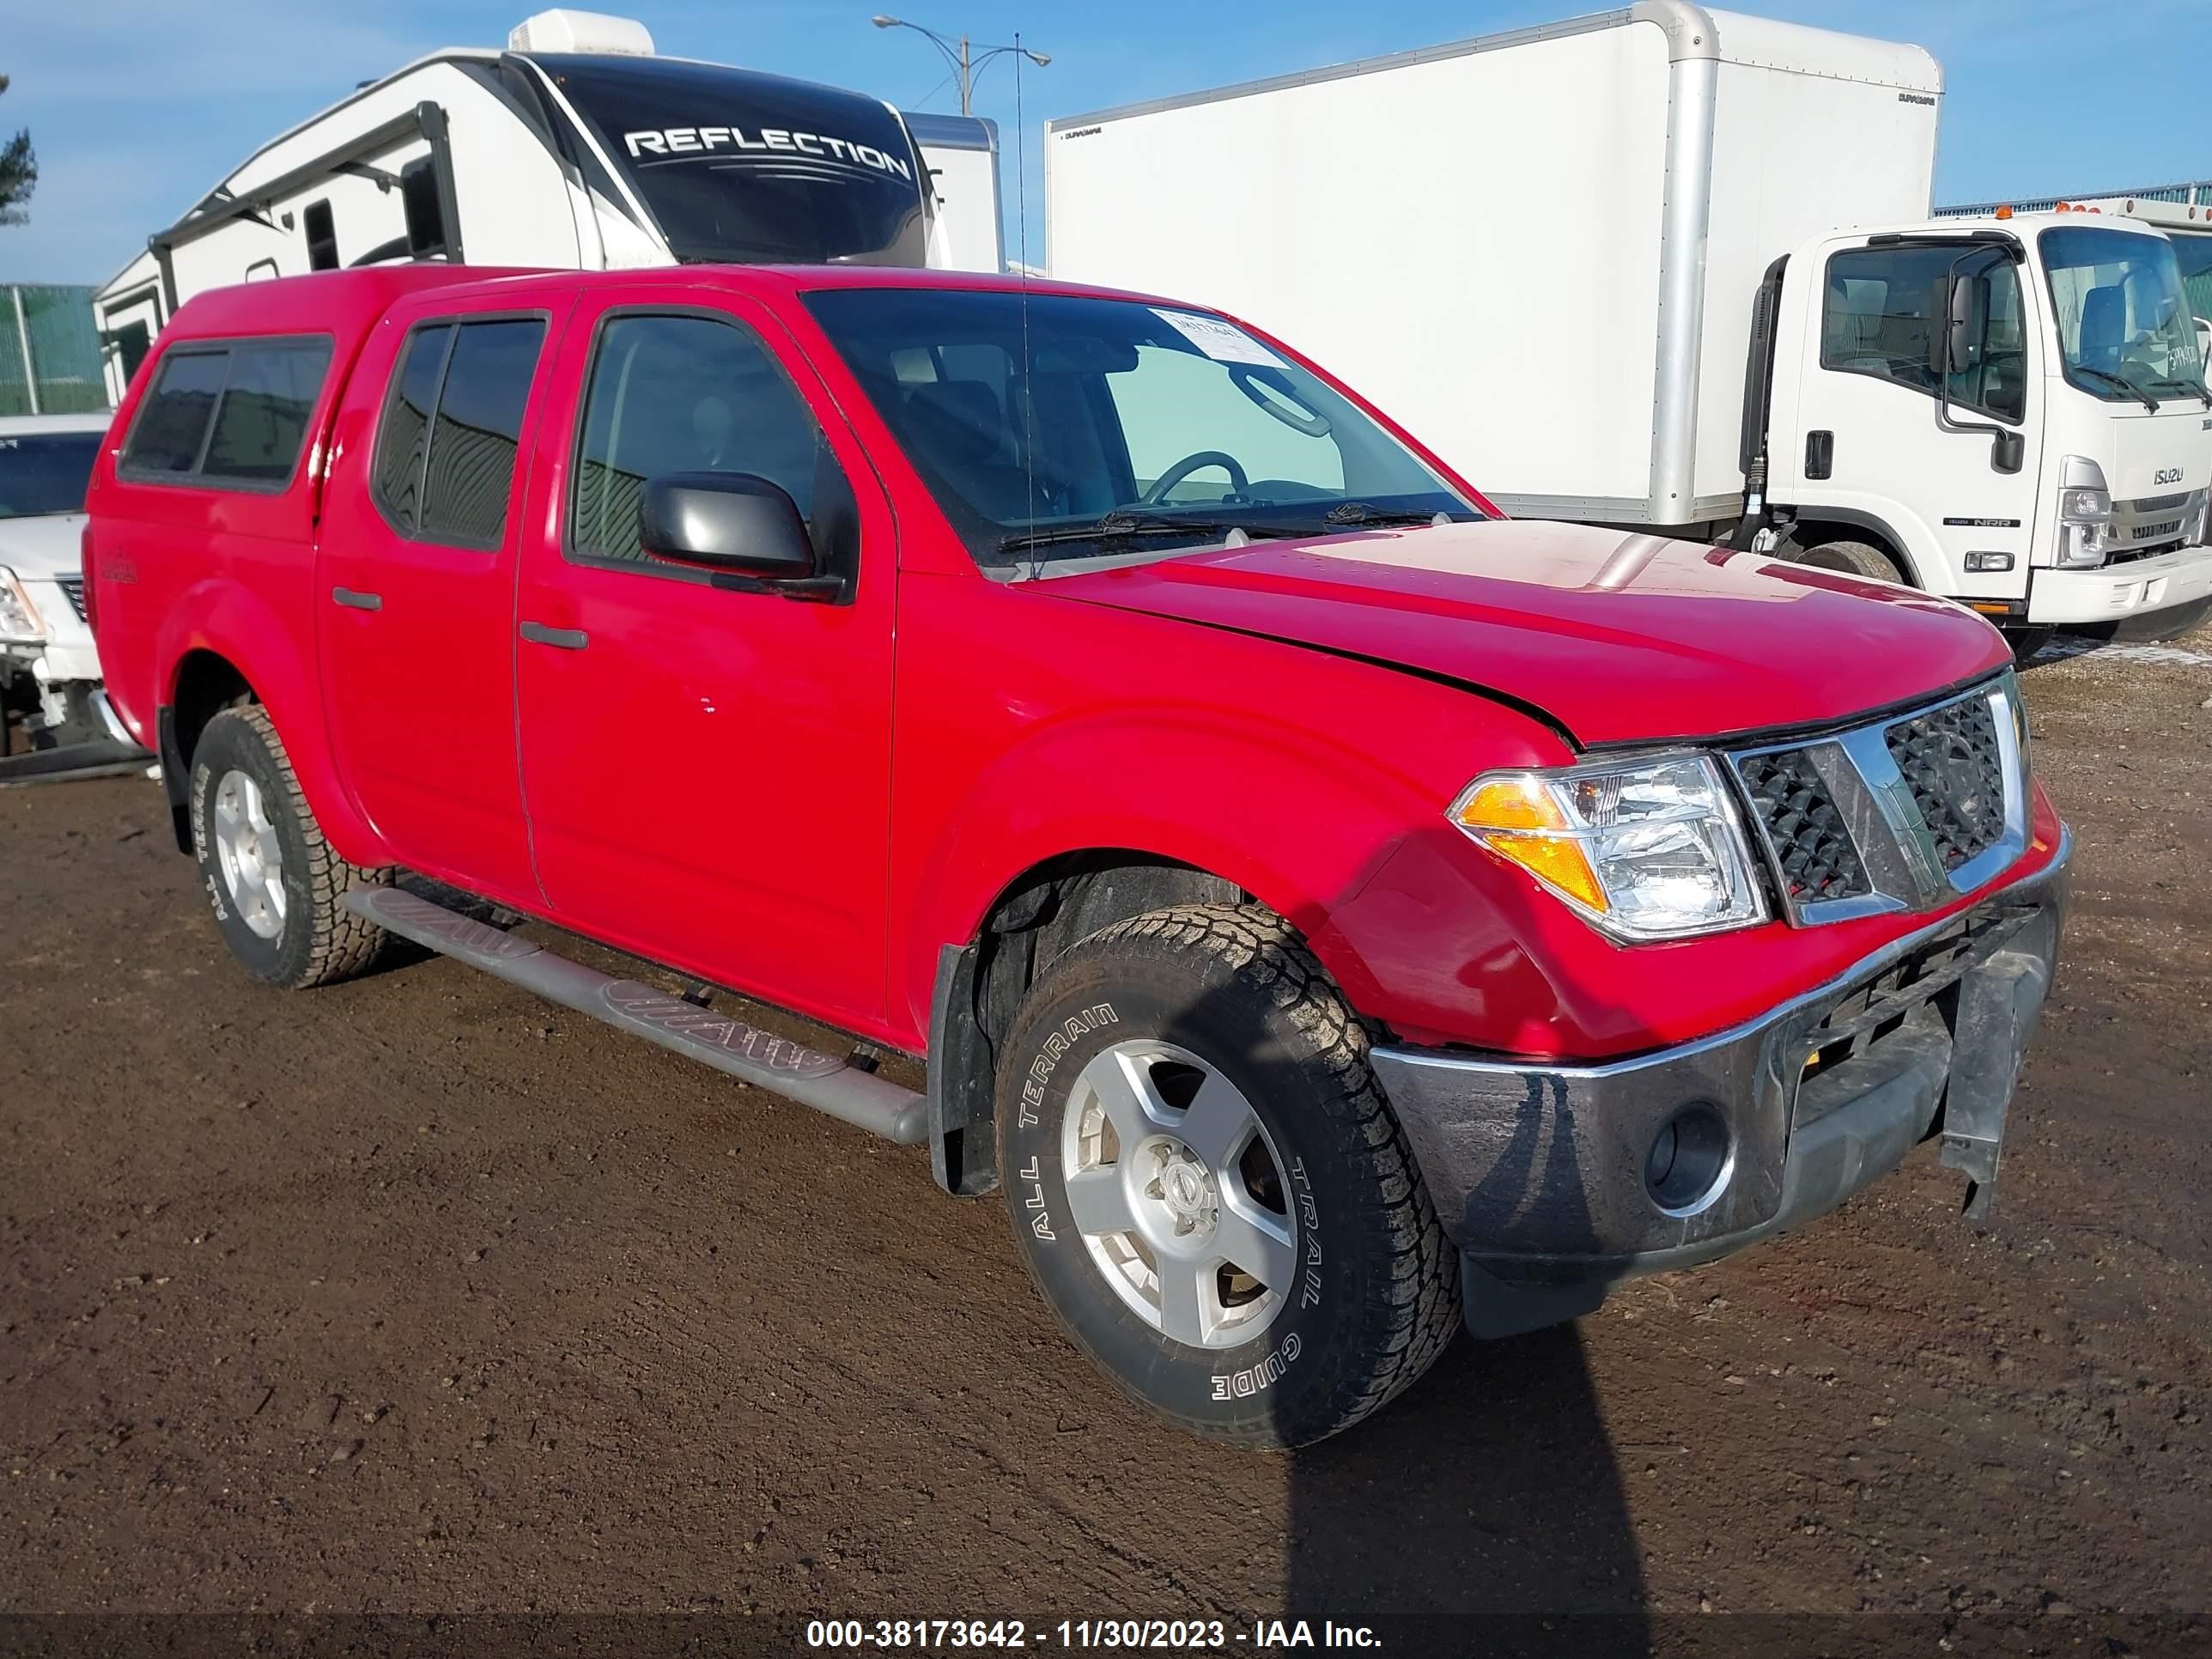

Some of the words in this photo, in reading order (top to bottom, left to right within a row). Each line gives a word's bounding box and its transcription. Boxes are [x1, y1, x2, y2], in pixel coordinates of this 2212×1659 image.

[624, 127, 912, 179] REFLECTION
[2154, 467, 2184, 486] ISUZU
[1974, 519, 2011, 527] NRR
[1018, 1003, 1119, 1128] TERRAIN
[1020, 1156, 1056, 1241] ALL
[1291, 1156, 1322, 1310] TRAIL
[1211, 1332, 1302, 1401] GUIDE
